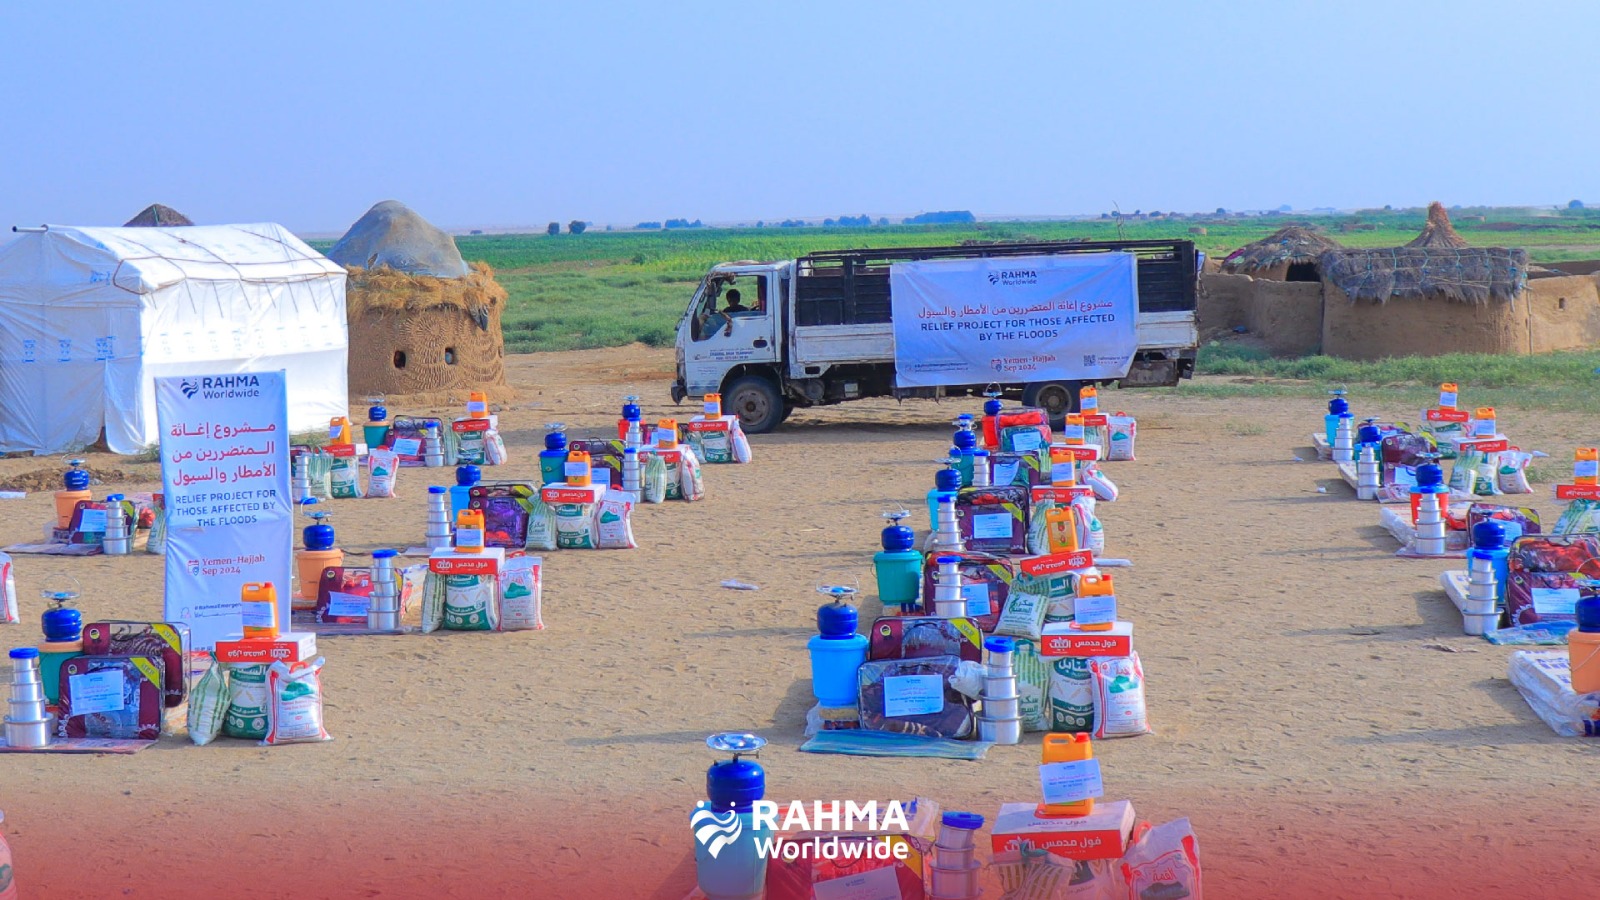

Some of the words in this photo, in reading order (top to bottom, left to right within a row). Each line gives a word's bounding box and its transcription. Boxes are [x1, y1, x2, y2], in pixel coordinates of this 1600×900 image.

[1001, 270, 1038, 279] RAHMA
[1002, 279, 1038, 287] Worldwide
[959, 303, 990, 318] الأمطار
[992, 306, 1006, 316] من
[1008, 301, 1055, 315] المتضررين
[1058, 300, 1078, 312] إغاثة
[1080, 300, 1113, 314] مشروع
[918, 306, 957, 319] والسيول
[921, 322, 955, 332] RELIEF
[957, 320, 1001, 330] PROJECT
[1005, 319, 1026, 328] FOR
[1030, 317, 1062, 327] THOSE
[1064, 313, 1115, 325] AFFECTED
[979, 333, 993, 341] BY
[996, 332, 1015, 341] THE
[1018, 329, 1058, 340] FLOODS
[1003, 363, 1017, 372] Sep
[1019, 363, 1036, 371] 2024
[202, 375, 260, 389] RAHMA
[203, 388, 260, 400] Worldwide
[170, 421, 210, 439] إغاثة
[213, 422, 276, 439] مشروع
[172, 448, 193, 463] من
[196, 441, 275, 461] المتضررين
[173, 466, 227, 486] والسيول
[231, 461, 276, 482] الأمطار
[175, 493, 207, 504] RELIEF
[210, 490, 253, 502] PROJECT
[256, 489, 276, 499] FOR
[176, 505, 208, 516] THOSE
[211, 502, 260, 514] AFFECTED
[263, 501, 276, 510] BY
[197, 517, 216, 527] THE
[219, 515, 257, 526] FLOODS
[202, 567, 218, 577] Sep
[220, 566, 241, 575] 2024
[194, 602, 242, 611] #RahmaEmergen
[1074, 640, 1101, 648] مدمس
[1101, 639, 1117, 648] فول
[1041, 839, 1078, 850] مدمس
[1080, 836, 1102, 848] فول
